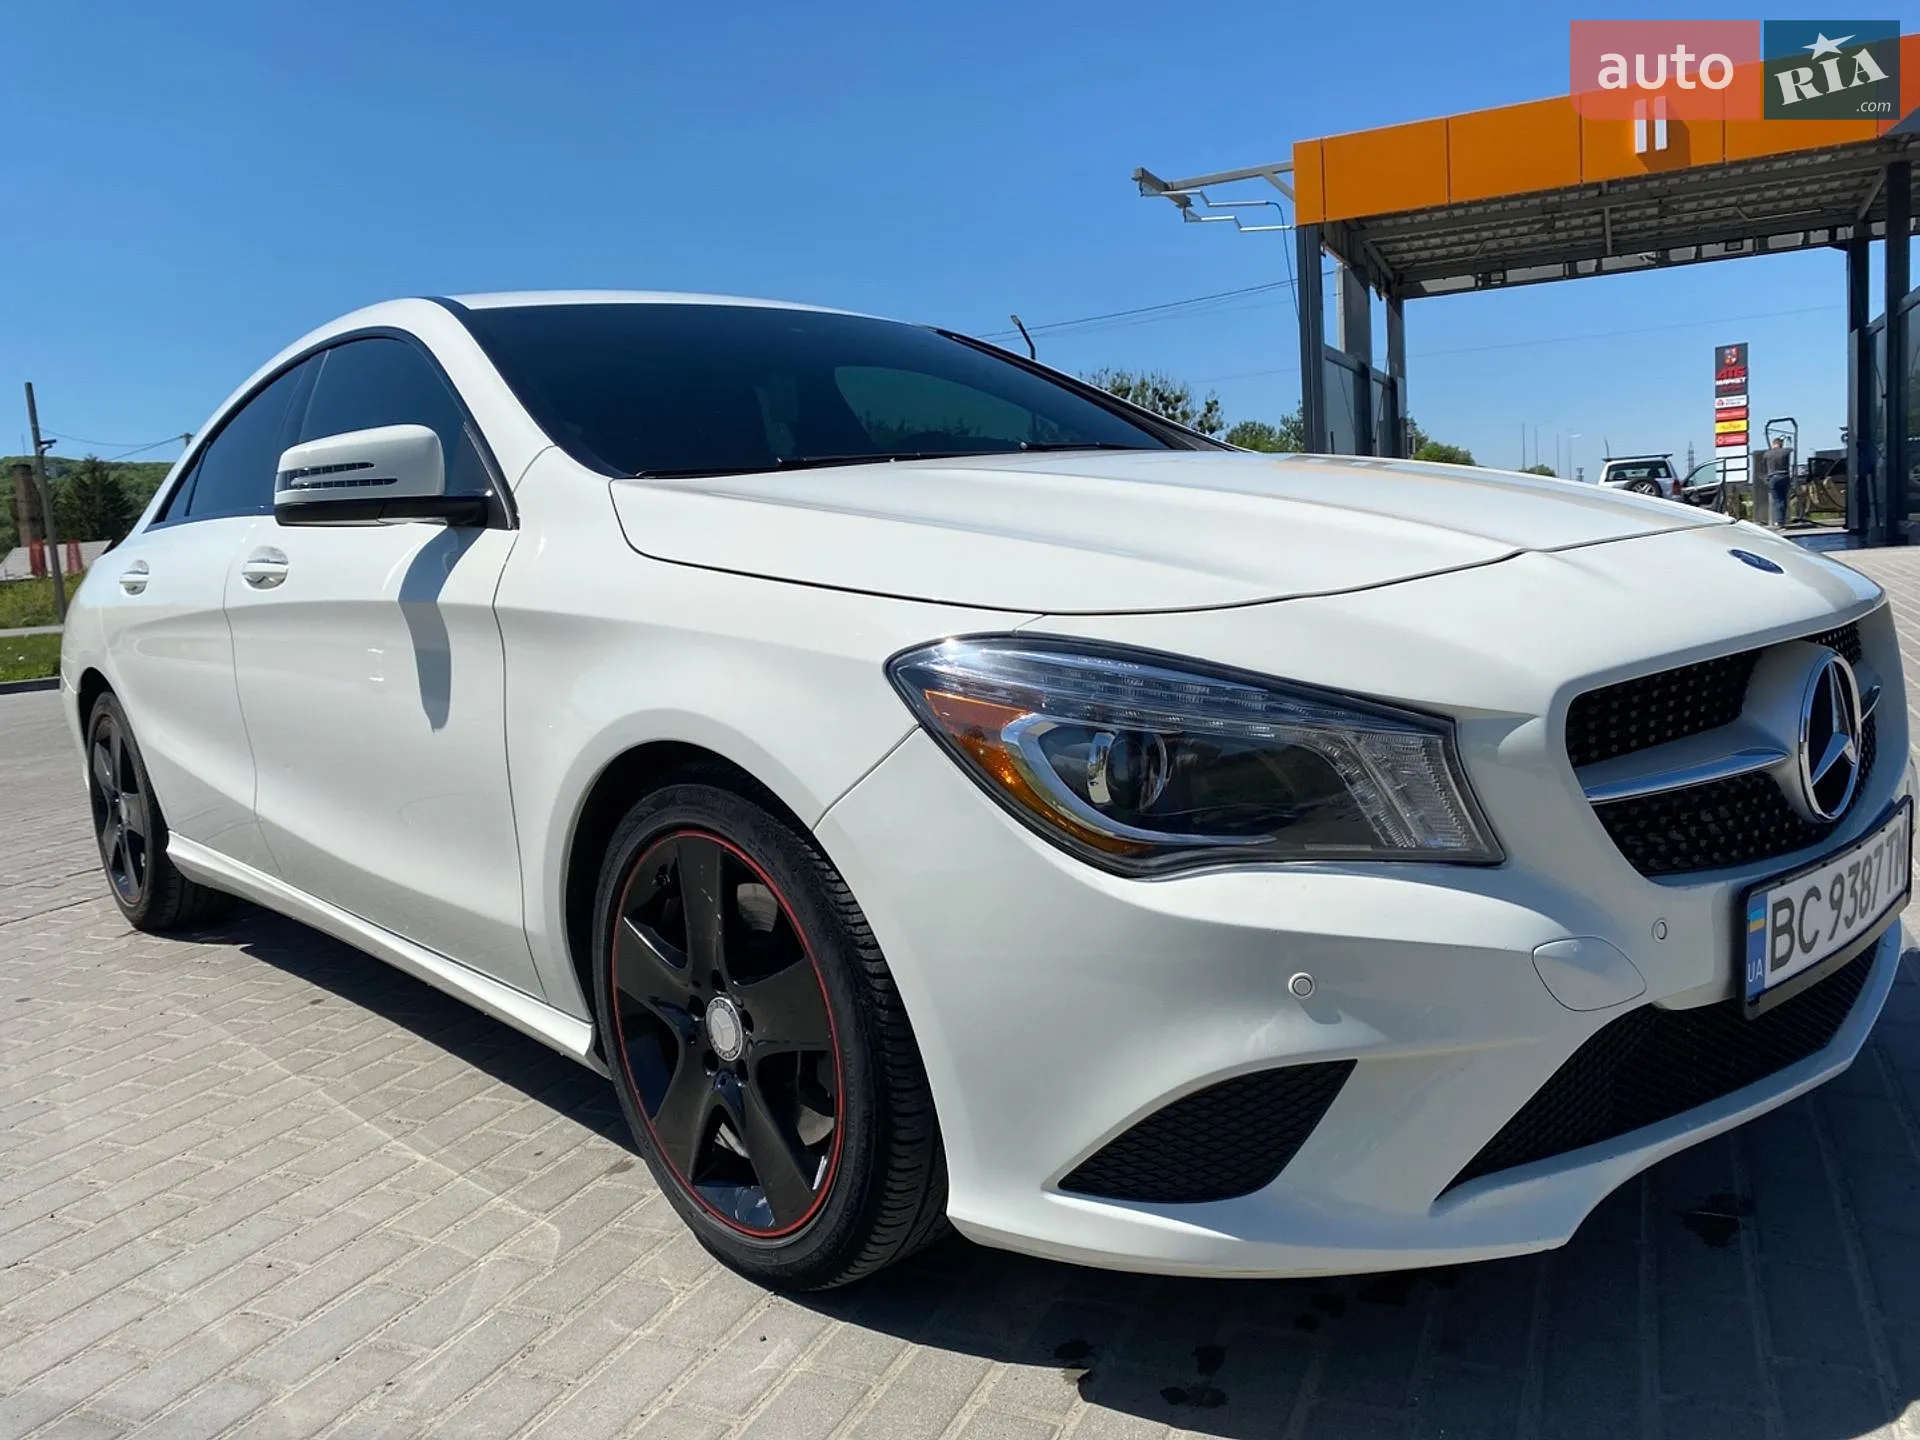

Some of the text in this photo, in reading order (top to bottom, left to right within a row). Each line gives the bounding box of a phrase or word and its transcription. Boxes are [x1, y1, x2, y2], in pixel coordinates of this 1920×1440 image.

[1771, 886, 1822, 972] BC
[1828, 845, 1883, 941] 9387
[1747, 958, 1763, 983] UA
